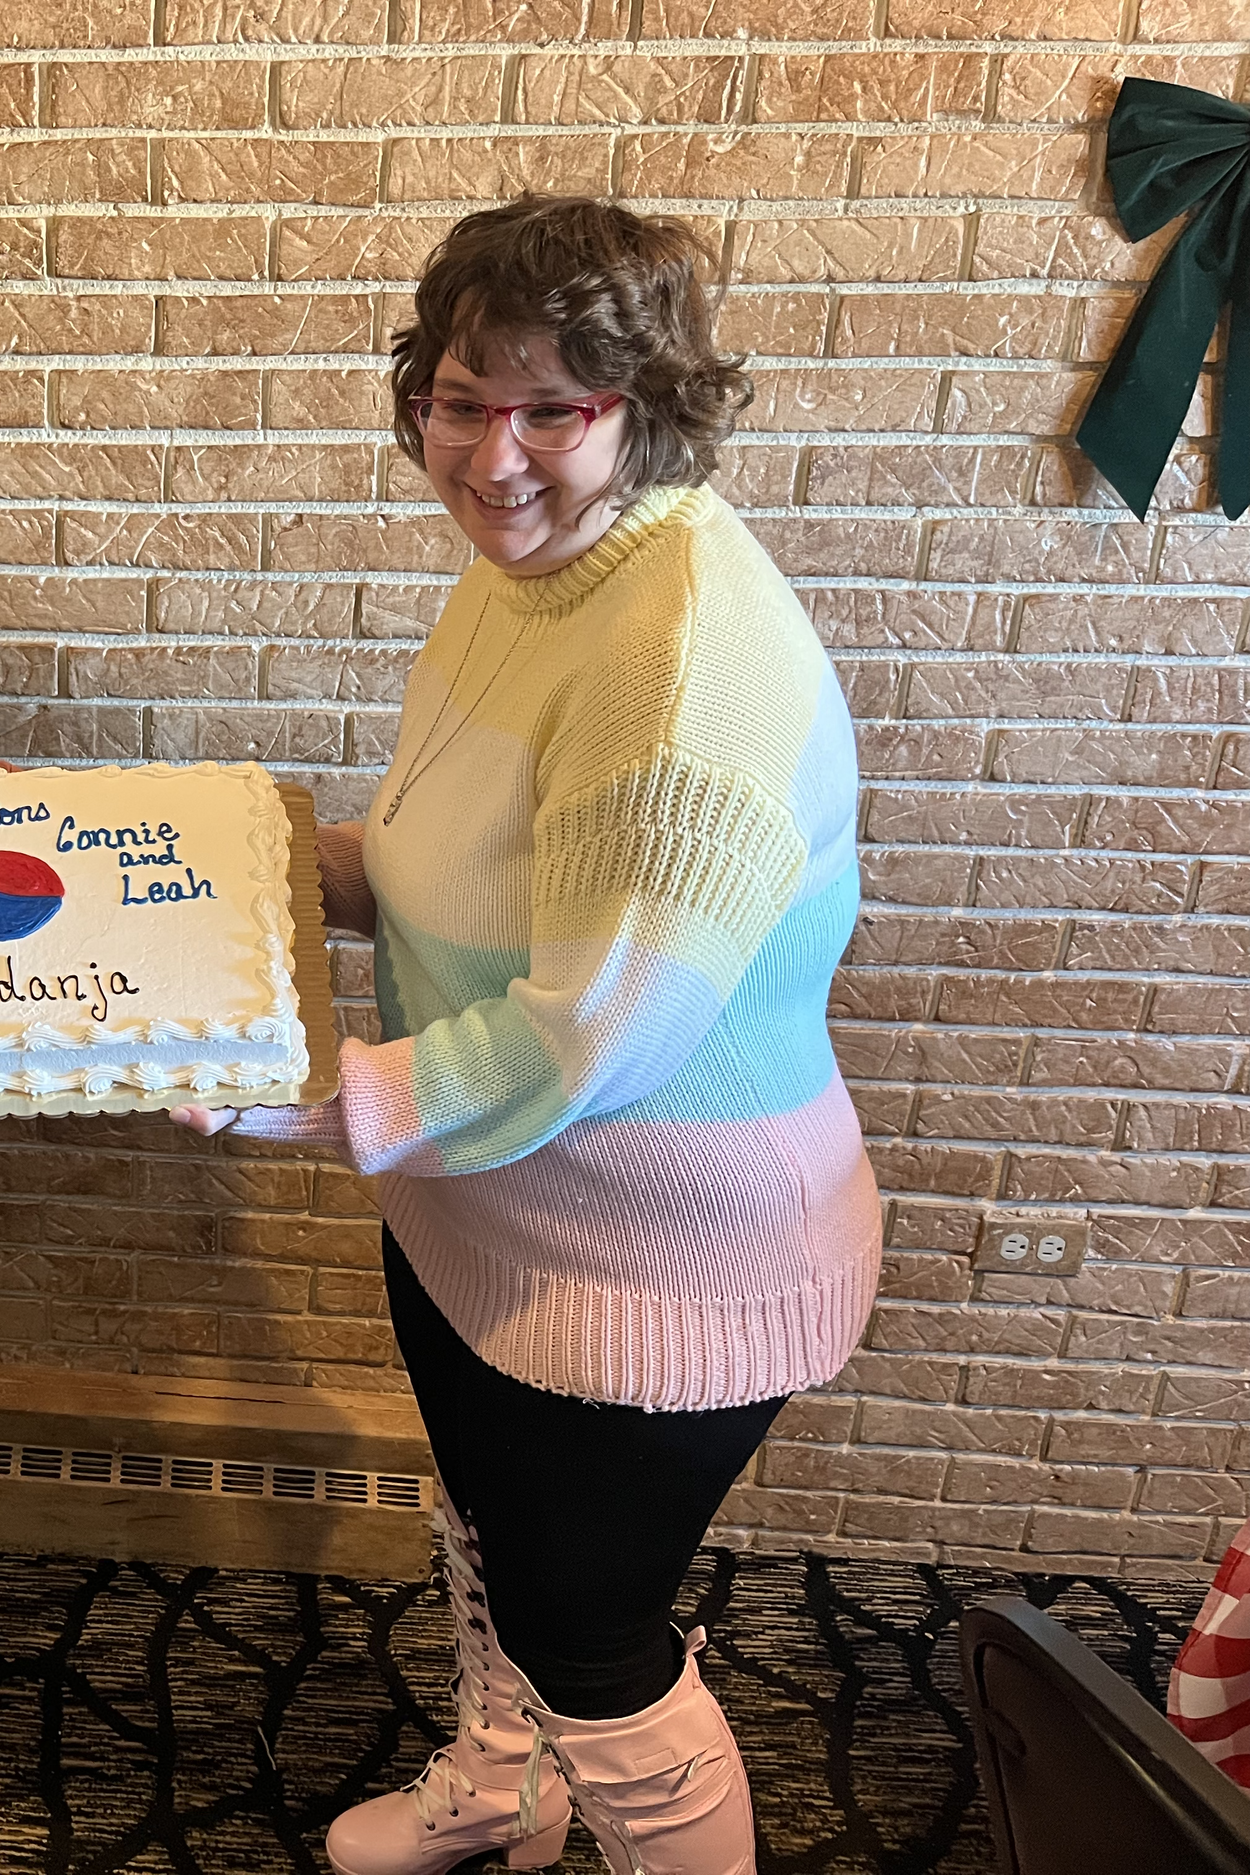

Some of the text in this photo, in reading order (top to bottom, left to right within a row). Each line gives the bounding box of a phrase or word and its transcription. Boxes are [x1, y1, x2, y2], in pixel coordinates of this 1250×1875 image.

[56, 815, 181, 853] Connie
[119, 843, 183, 868] and
[121, 867, 218, 906] Leah
